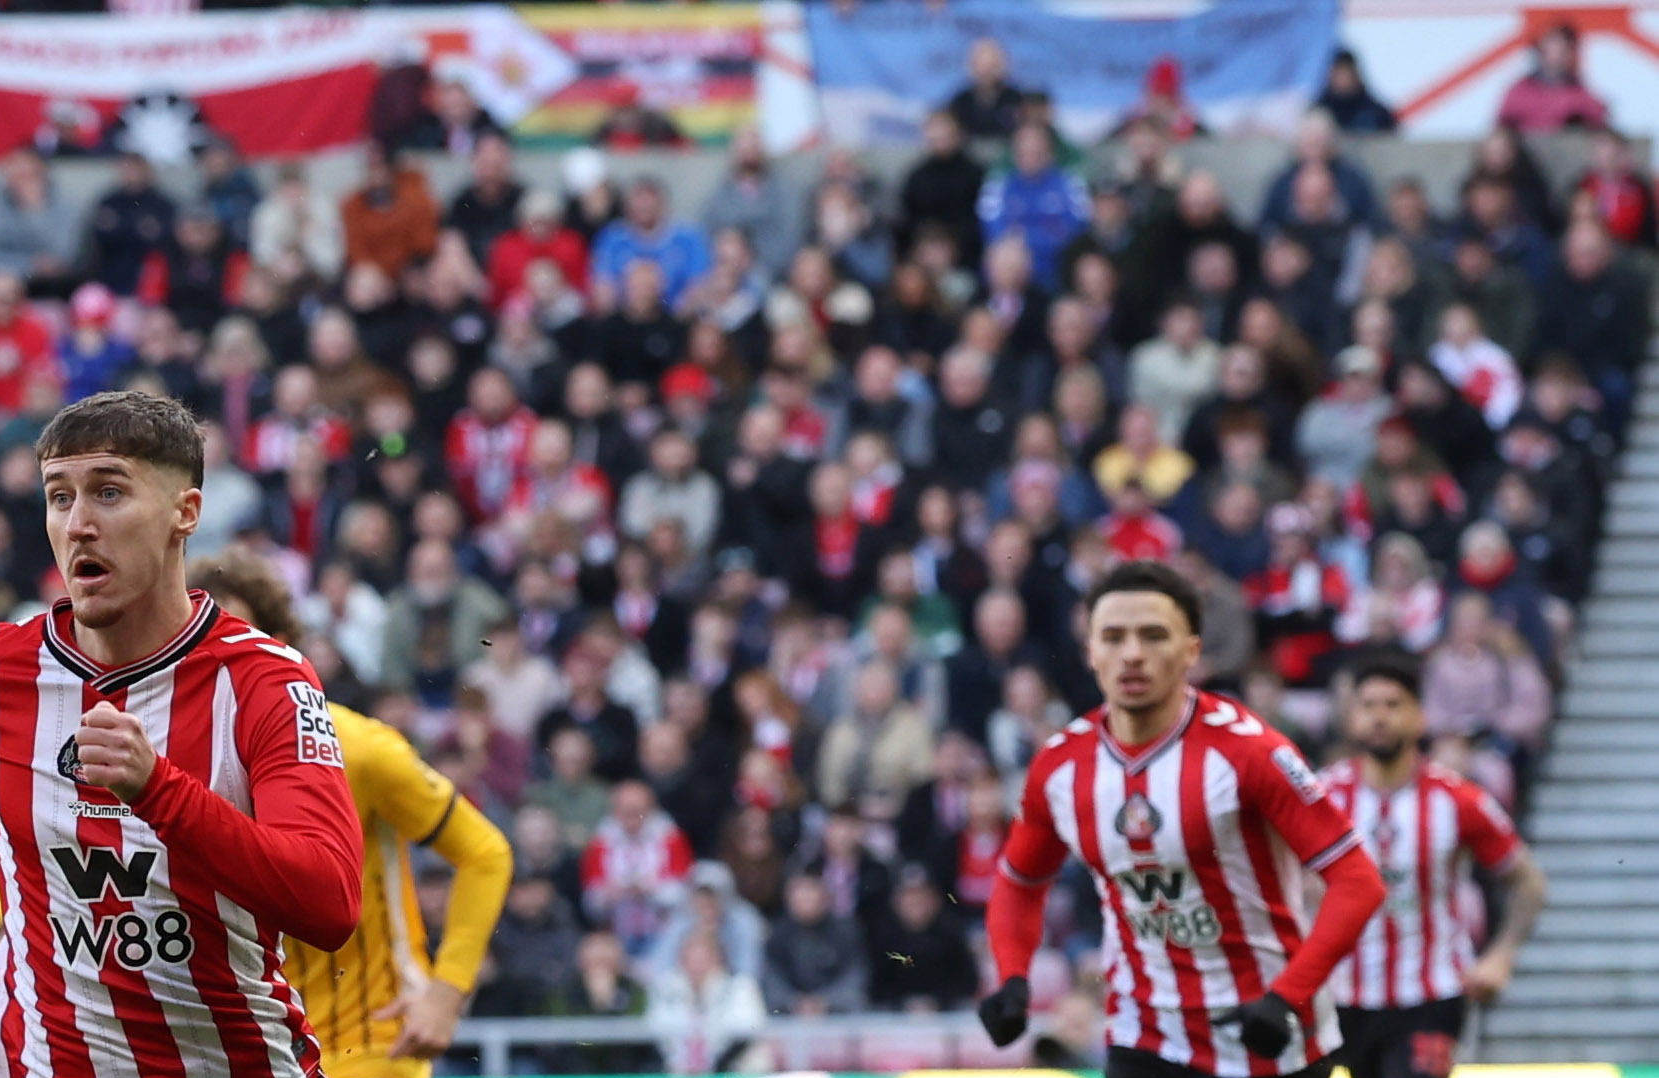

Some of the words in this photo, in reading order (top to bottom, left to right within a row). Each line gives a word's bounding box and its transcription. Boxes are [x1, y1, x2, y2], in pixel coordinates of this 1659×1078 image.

[291, 685, 329, 711] Liv
[300, 708, 336, 738] Sco
[301, 734, 343, 764] Bet
[84, 803, 133, 817] humme
[48, 910, 193, 969] W88
